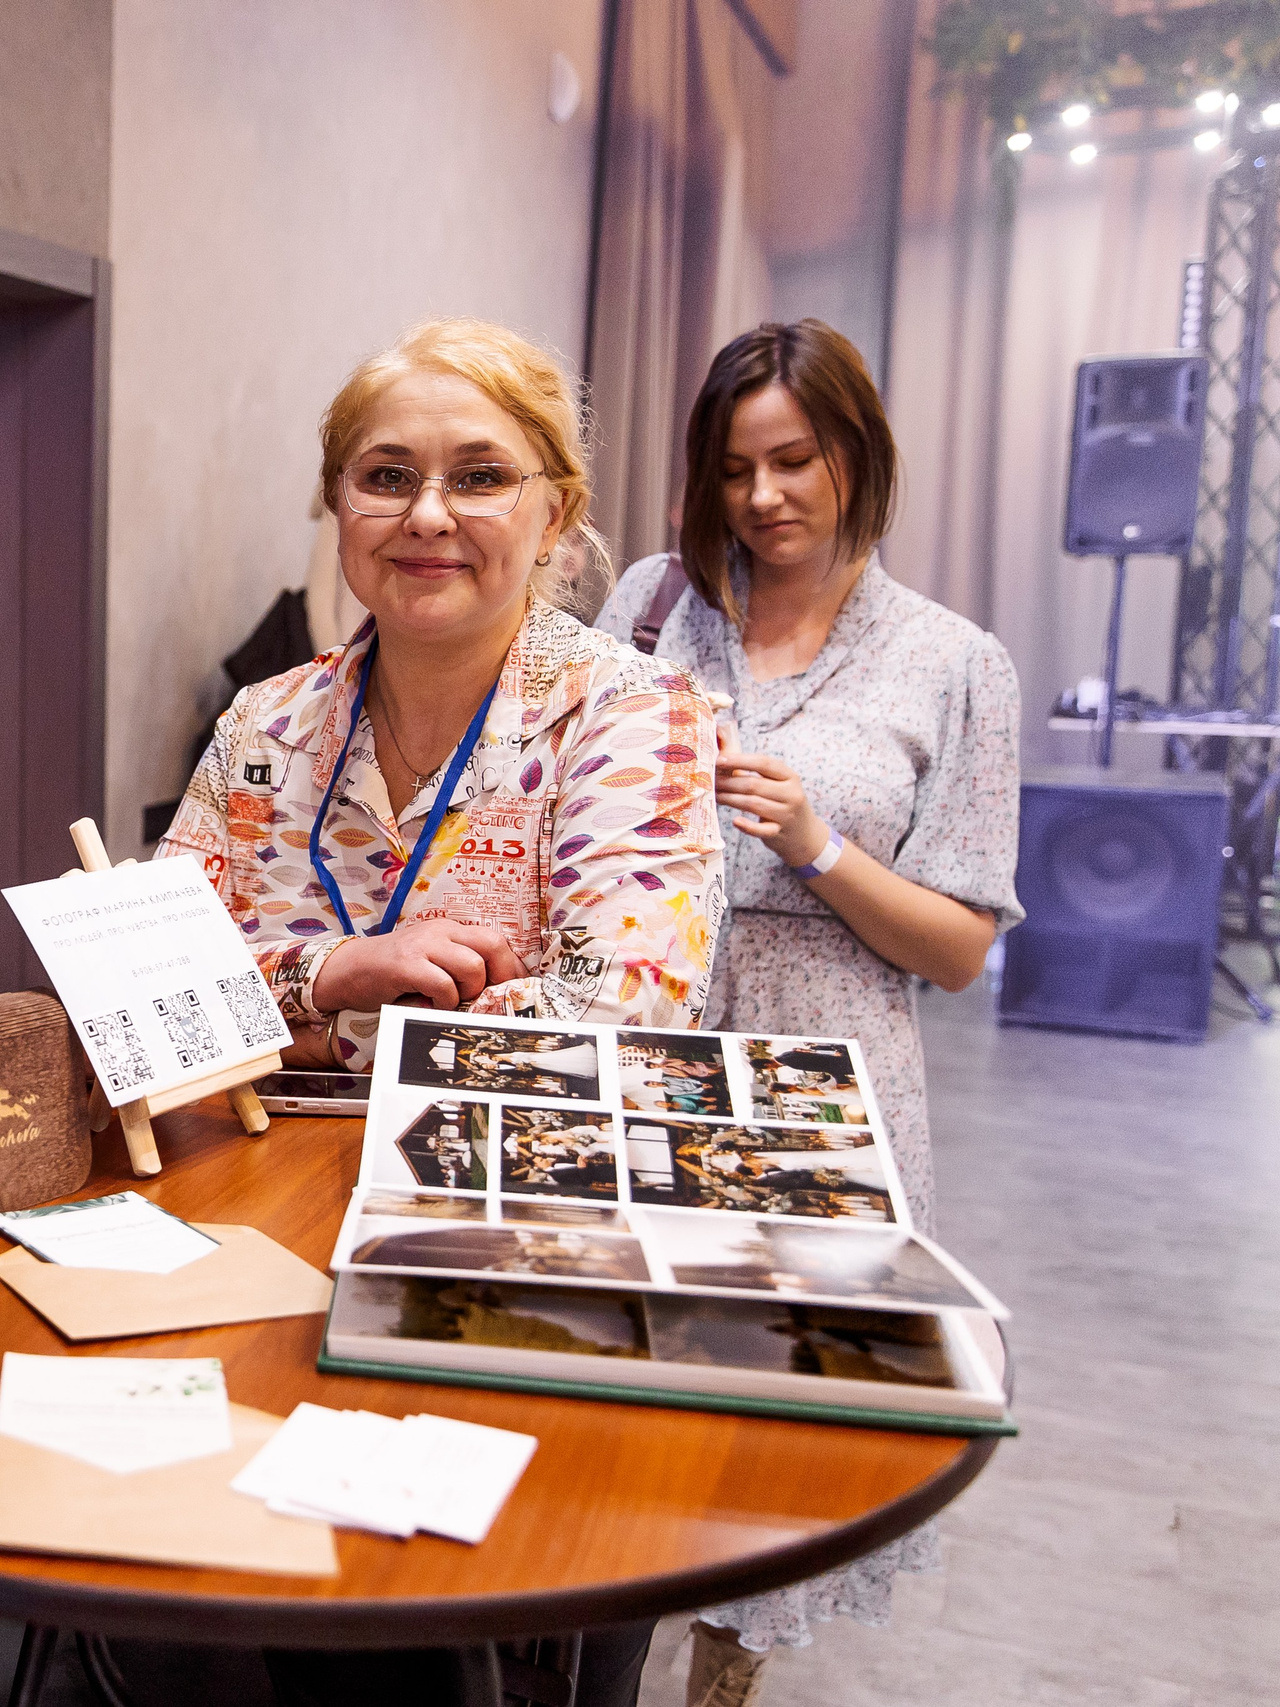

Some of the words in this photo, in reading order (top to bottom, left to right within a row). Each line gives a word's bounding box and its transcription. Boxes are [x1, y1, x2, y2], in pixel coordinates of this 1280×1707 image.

[458, 838, 526, 858] 013
[41, 908, 100, 927] ФОТОГРАФ
[103, 898, 148, 915] МАРИНА
[149, 885, 204, 905] КЛИПАЧЕВА
[53, 938, 72, 950] ПРО
[107, 925, 125, 937] ПРО
[162, 913, 179, 924] ПРО
